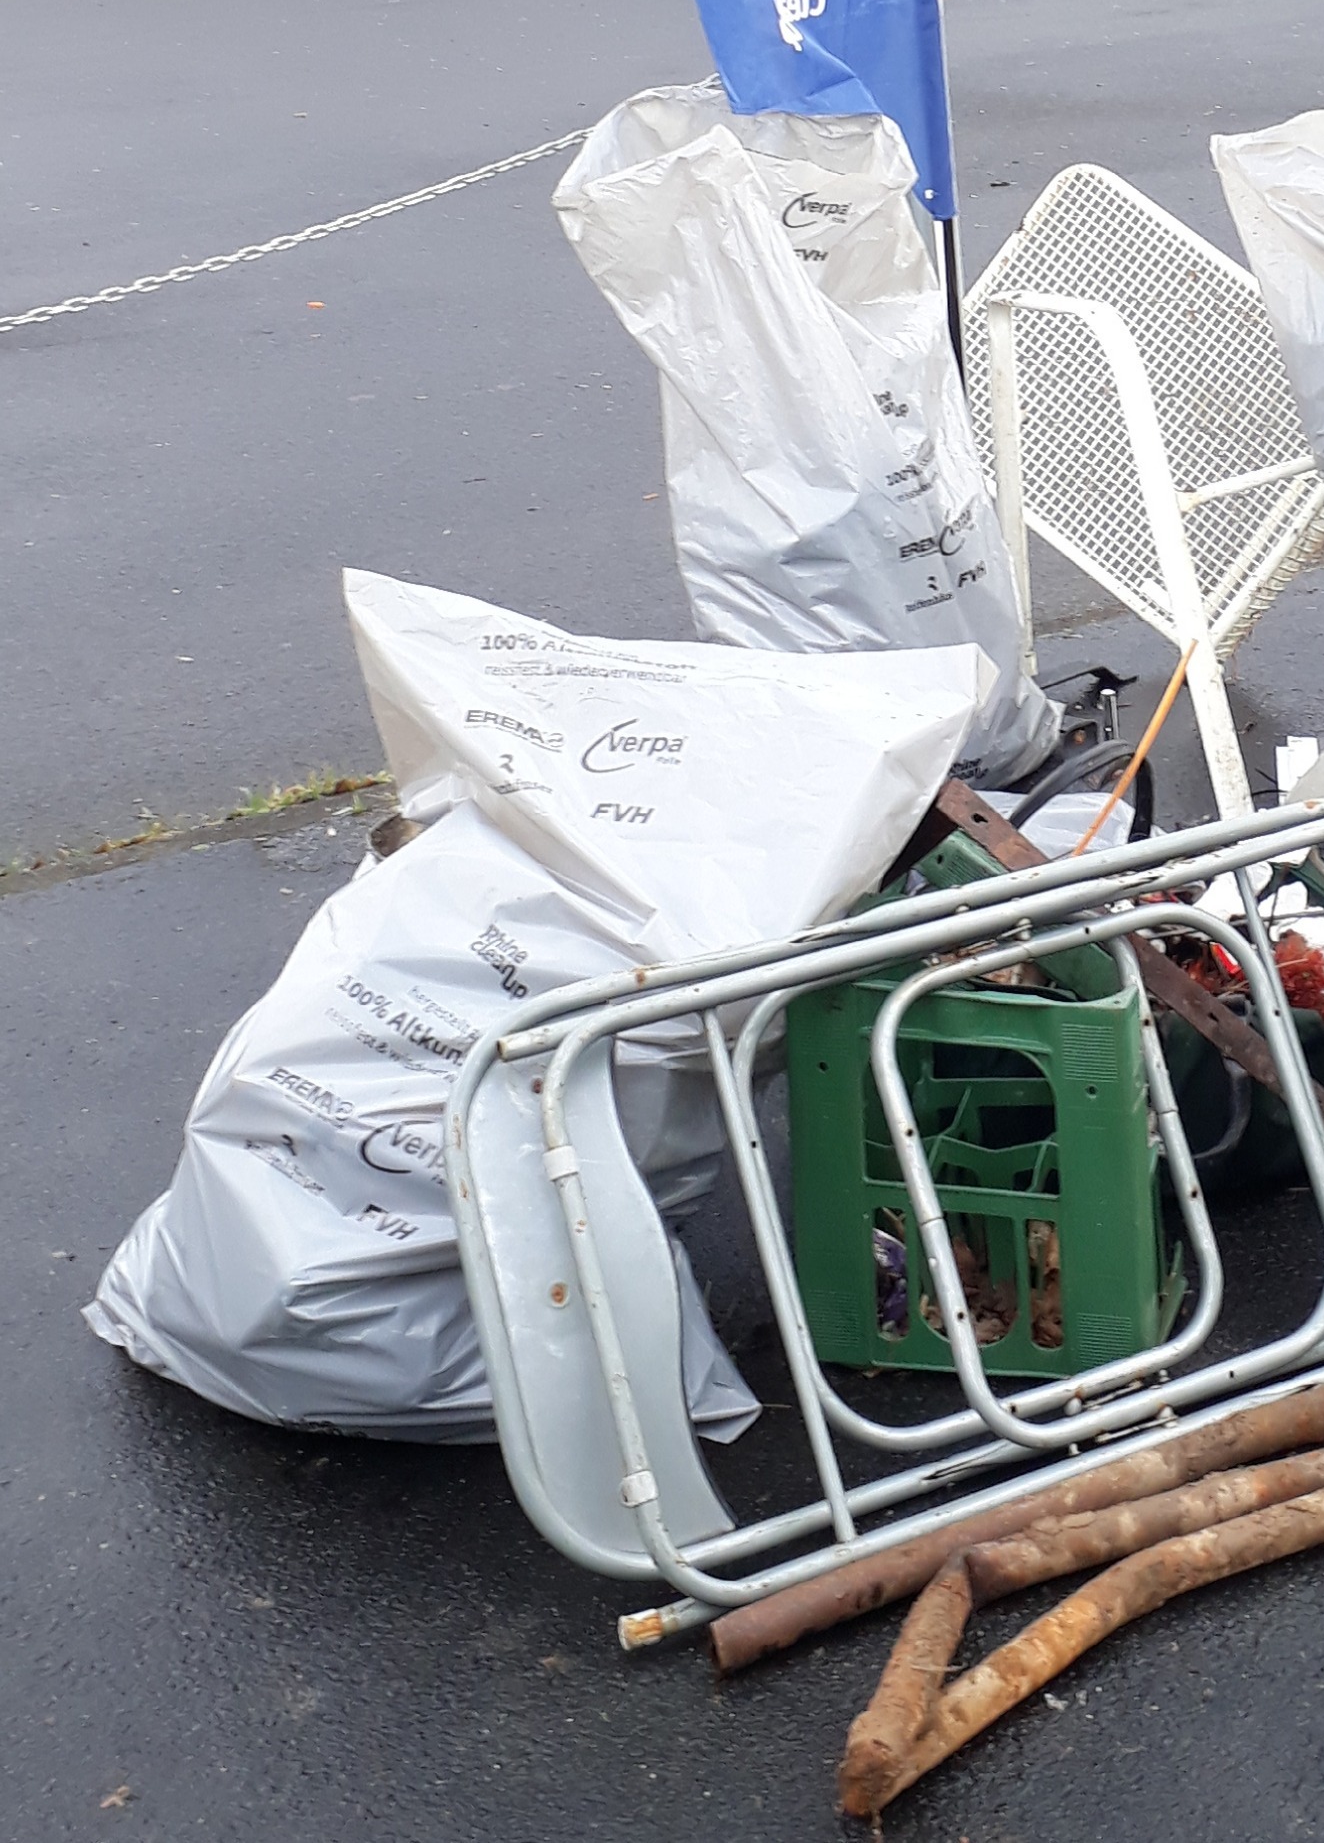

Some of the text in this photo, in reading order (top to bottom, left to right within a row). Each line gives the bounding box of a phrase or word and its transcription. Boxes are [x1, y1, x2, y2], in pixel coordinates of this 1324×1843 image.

[590, 803, 655, 824] FVH
[337, 974, 393, 1019] 100%
[387, 1011, 463, 1066] Altkun
[390, 1124, 447, 1169] verp
[356, 1203, 419, 1240] FVH
